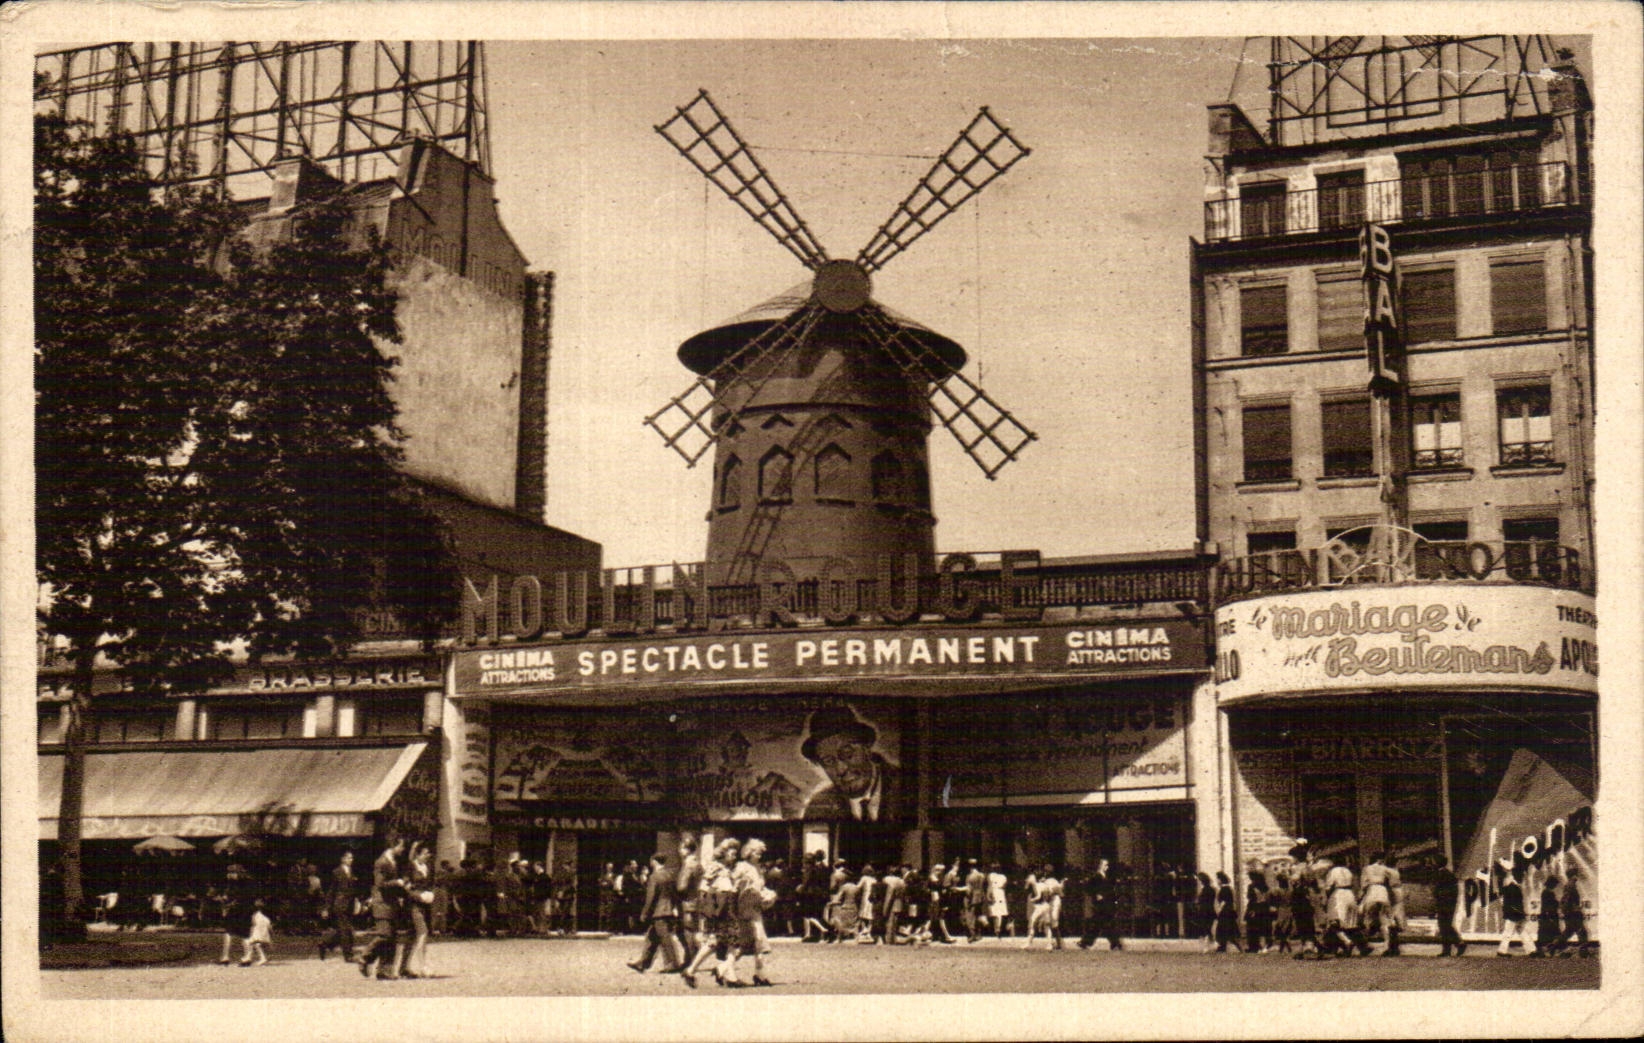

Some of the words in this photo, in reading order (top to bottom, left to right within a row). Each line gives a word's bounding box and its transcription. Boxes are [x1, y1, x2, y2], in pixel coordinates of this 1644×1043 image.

[1370, 224, 1398, 381] BAL
[462, 560, 707, 644] MOULIN
[758, 550, 1042, 624] ROUGE
[577, 643, 770, 676] SPECTACLE
[796, 635, 1039, 666] PERMANENT
[1066, 645, 1172, 665] ATTRACTIONS
[248, 667, 429, 692] BRASSERIE
[479, 666, 556, 685] ATTRACTIONS
